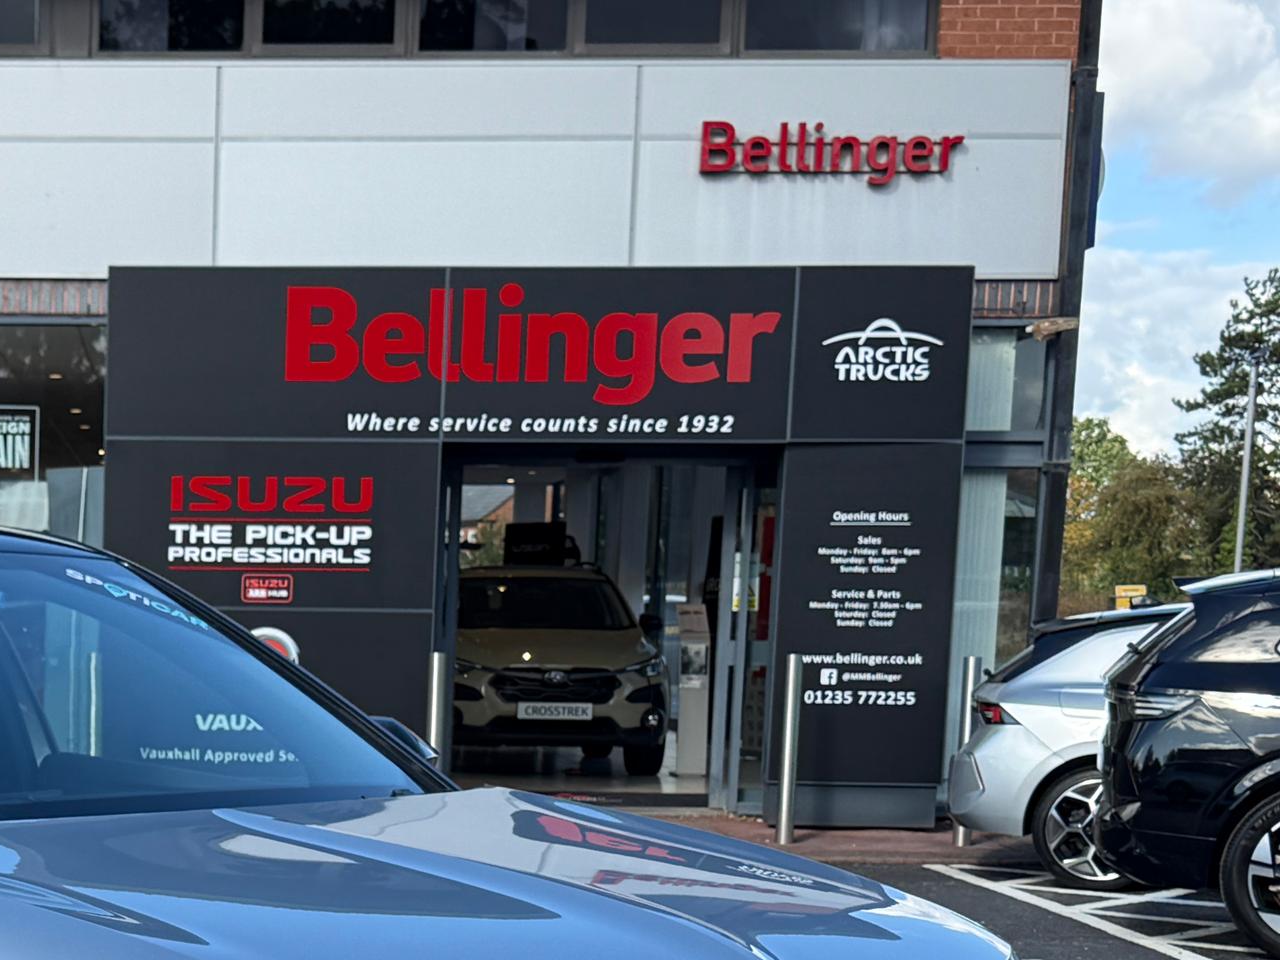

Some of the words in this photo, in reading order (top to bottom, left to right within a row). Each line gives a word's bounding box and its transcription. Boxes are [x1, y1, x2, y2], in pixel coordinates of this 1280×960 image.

[699, 121, 965, 185] Bellinger
[285, 285, 781, 405] Bellinger
[834, 346, 930, 362] ARCTIC
[834, 363, 930, 382] TRUCKS
[347, 414, 421, 431] Where
[428, 415, 512, 432] service
[521, 416, 599, 432] counts
[607, 416, 668, 432] since
[677, 416, 735, 432] 1932
[171, 475, 373, 512] ISUZU
[832, 510, 877, 523] Opening
[878, 511, 909, 521] Hours
[168, 524, 233, 544] THE
[245, 525, 373, 545] PICK-UP
[857, 535, 882, 545] Sales
[168, 547, 371, 563] PROFESSIONALS
[817, 547, 848, 556] Monday
[871, 565, 897, 573] Closed
[245, 579, 289, 589] ISUZU
[831, 589, 866, 599] Service
[866, 589, 875, 599] &
[877, 589, 902, 599] Parts
[808, 601, 840, 610] Monday
[871, 610, 897, 618] Closed
[868, 619, 894, 627] Closed
[802, 652, 923, 667] www.bellinger.co.uk
[803, 690, 853, 705] 01235
[857, 691, 916, 706] 772255
[524, 705, 589, 717] CROSSTREK
[140, 746, 199, 762] Vauxhall
[204, 748, 273, 764] Approved
